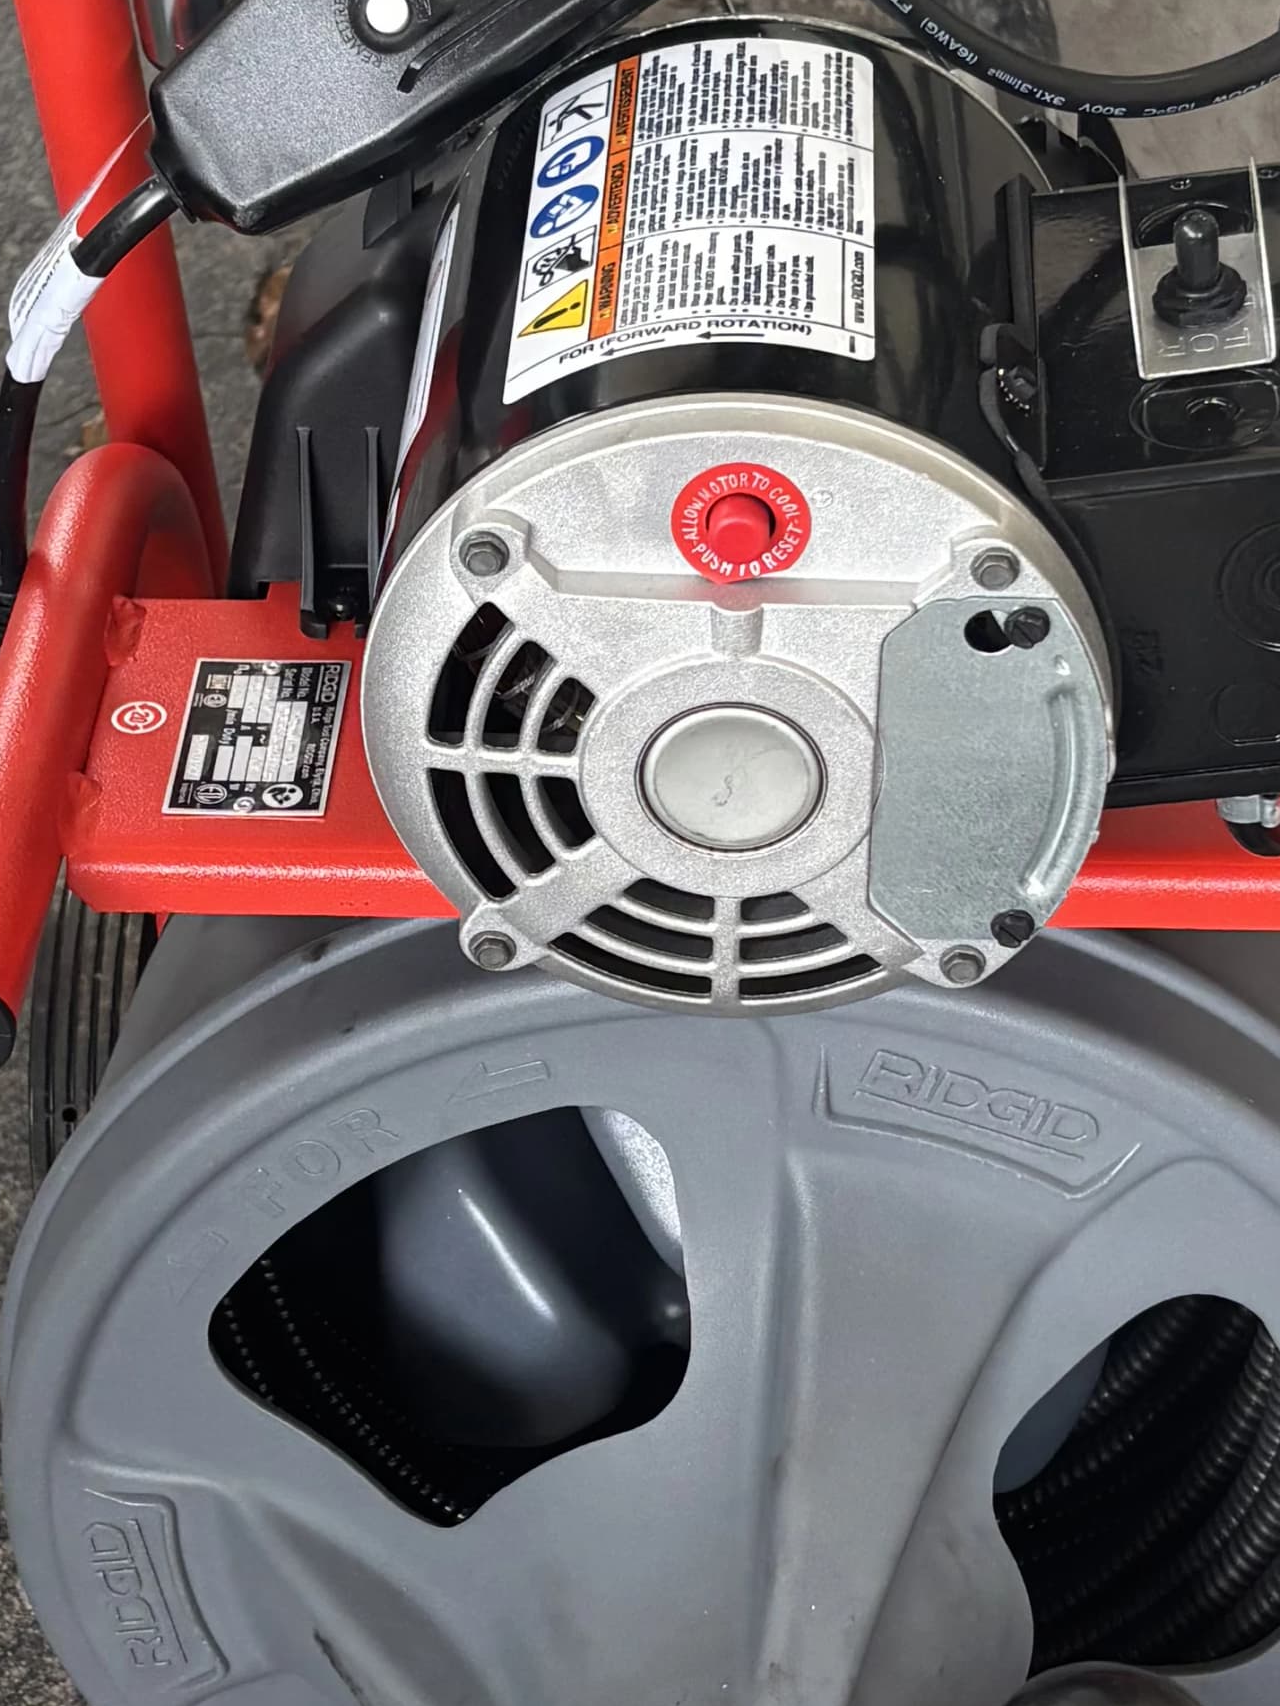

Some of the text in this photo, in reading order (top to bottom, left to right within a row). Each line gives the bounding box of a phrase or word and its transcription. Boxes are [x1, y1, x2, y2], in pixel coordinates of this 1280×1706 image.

[919, 15, 979, 66] (16AWG)
[1078, 102, 1127, 117] 300V
[605, 161, 626, 225] ADVERTENCIA
[598, 262, 615, 310] WARNING
[850, 251, 864, 323] www.RIDGID.com
[559, 320, 812, 364] FOR (FORWARD ROTATION)
[1158, 327, 1252, 358] FOR
[680, 497, 704, 540] ALLOW
[699, 471, 748, 501] MOTOR
[751, 470, 769, 489] TO
[282, 668, 296, 685] Serial
[298, 667, 313, 686] Model
[323, 664, 340, 703] RIDGID
[857, 1048, 1101, 1147] RIDGID
[245, 1104, 401, 1220] FOR
[83, 1518, 173, 1670] RIDGID
